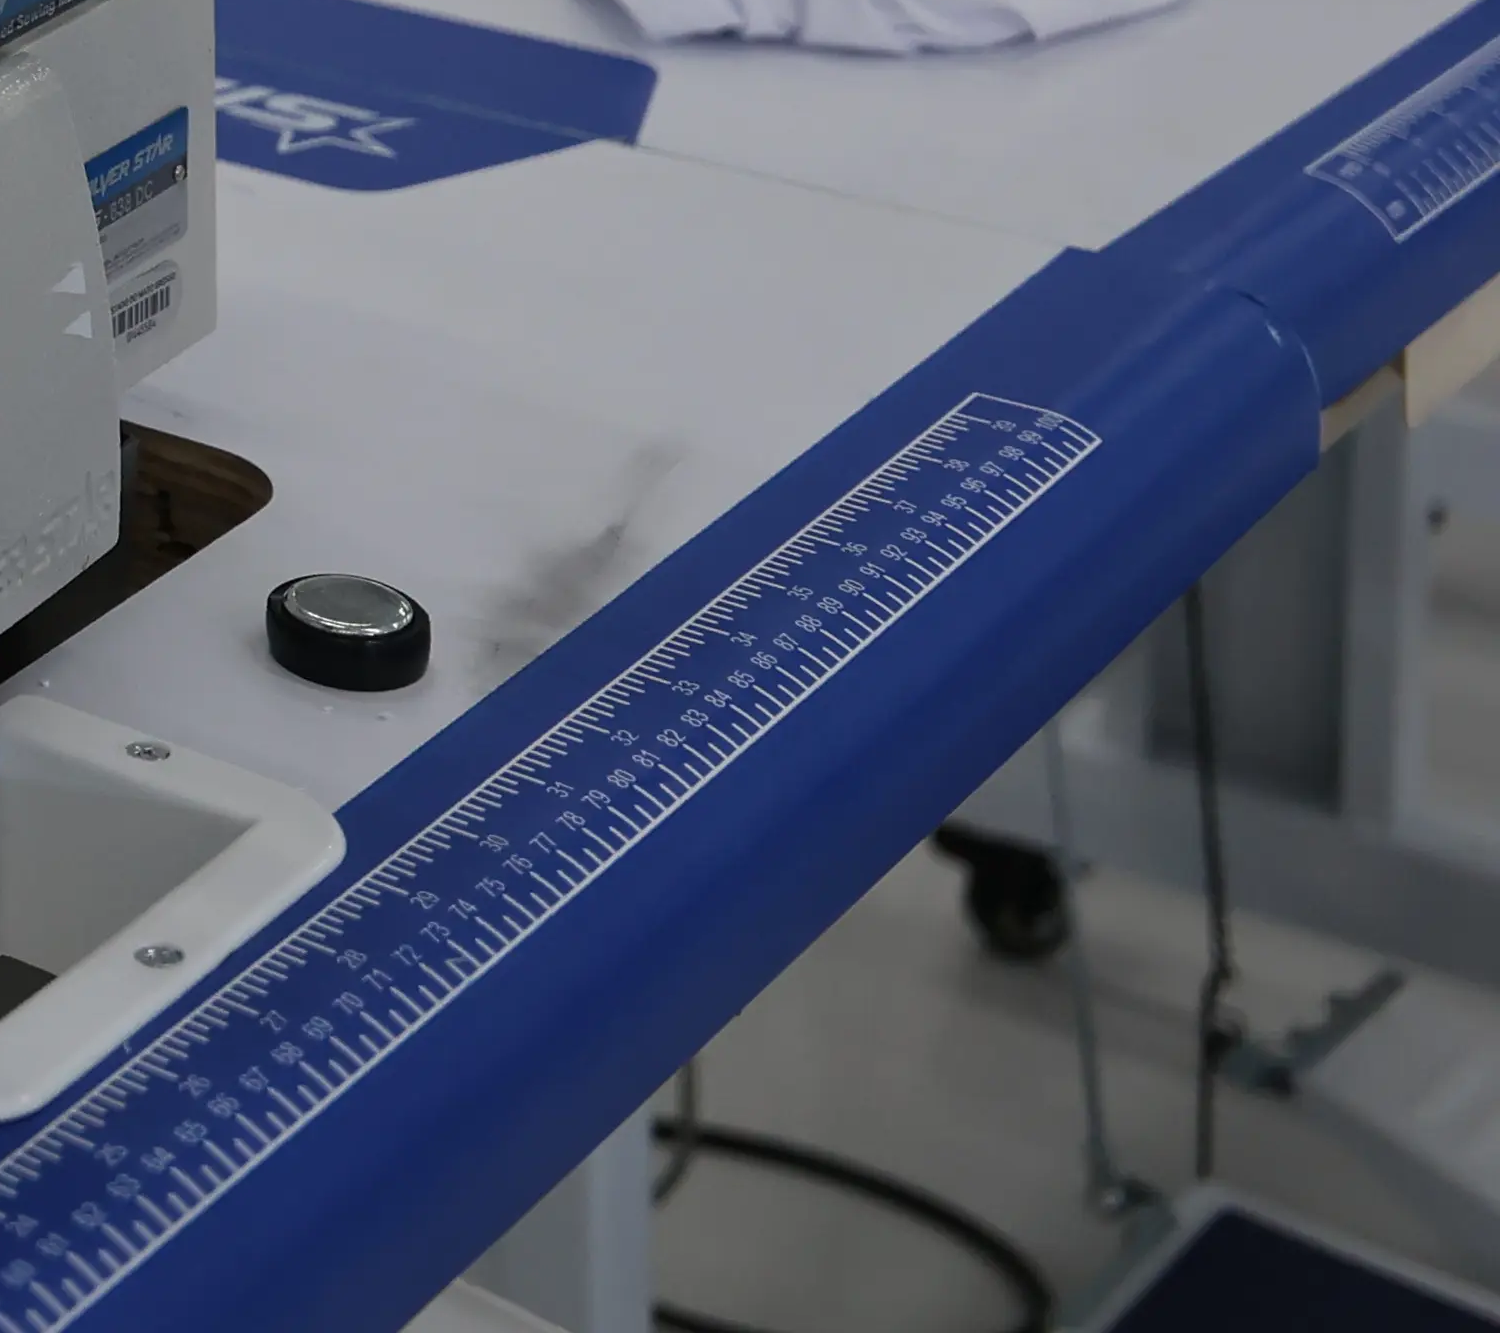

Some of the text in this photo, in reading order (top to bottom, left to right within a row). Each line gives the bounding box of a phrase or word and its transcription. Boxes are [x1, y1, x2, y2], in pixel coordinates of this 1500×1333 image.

[17, 0, 56, 31] Sewing
[90, 134, 173, 197] ILVER STAR
[135, 180, 153, 206] DC
[332, 991, 364, 1014] 70
[361, 968, 394, 990] 71
[390, 944, 423, 966] 72
[420, 921, 450, 943] 73
[448, 898, 477, 920] 74
[475, 877, 505, 898] 75
[502, 854, 533, 875] 76
[529, 832, 557, 854] 77
[555, 811, 586, 831] 78
[581, 789, 612, 810] 79
[607, 769, 636, 789] 80
[631, 749, 661, 768] 81
[656, 728, 686, 748] 82
[680, 709, 709, 727] 83
[704, 689, 732, 708] 84
[727, 670, 755, 689] 85
[750, 651, 778, 670] 86
[773, 633, 800, 651] 87
[795, 614, 823, 633] 88
[816, 596, 844, 615] 89
[838, 579, 866, 596] 90
[859, 561, 886, 579] 91
[880, 544, 908, 561] 92
[900, 527, 928, 544] 93
[920, 510, 948, 527] 94
[940, 494, 967, 510] 95
[960, 477, 987, 493] 96
[979, 461, 1005, 477] 97
[998, 445, 1025, 461] 98
[260, 1010, 287, 1031] 27
[336, 949, 367, 970] 28
[410, 890, 440, 910] 29
[479, 834, 510, 853] 30
[546, 781, 574, 798] 31
[610, 729, 640, 746] 32
[671, 679, 700, 696] 33
[730, 631, 759, 648] 34
[787, 585, 814, 601] 35
[841, 542, 868, 556] 36
[893, 499, 918, 515] 37
